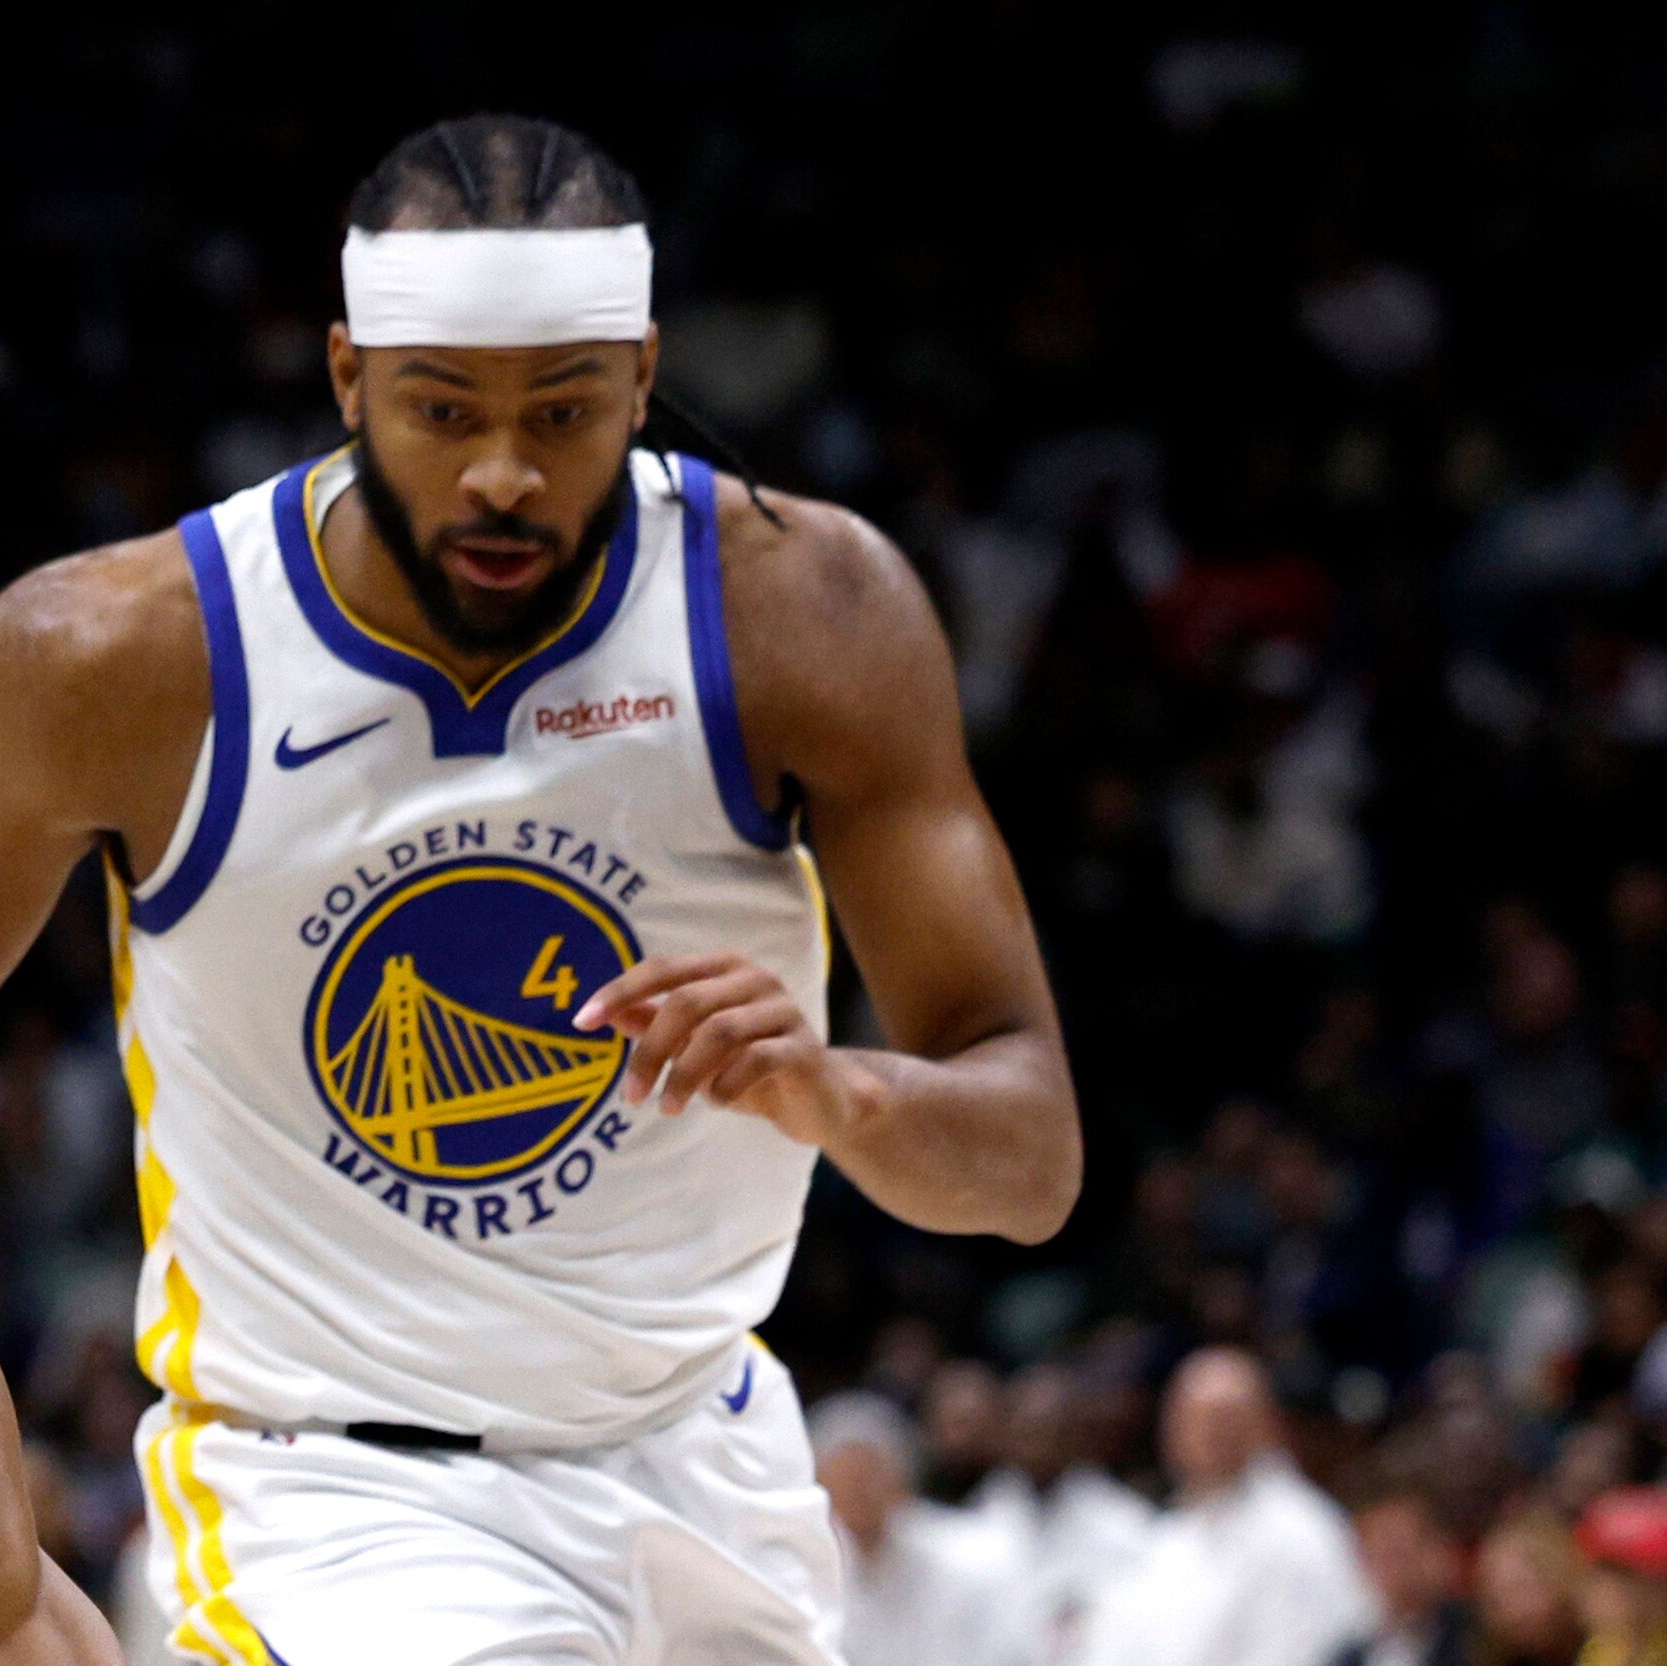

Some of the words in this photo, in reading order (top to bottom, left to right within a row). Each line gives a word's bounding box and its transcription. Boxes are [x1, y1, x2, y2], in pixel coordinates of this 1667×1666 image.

[536, 695, 674, 738] Rakuten
[301, 820, 486, 947] GOLDEN
[515, 820, 648, 903] STATE
[520, 936, 578, 1009] 4
[321, 1111, 632, 1239] WARRIOR
